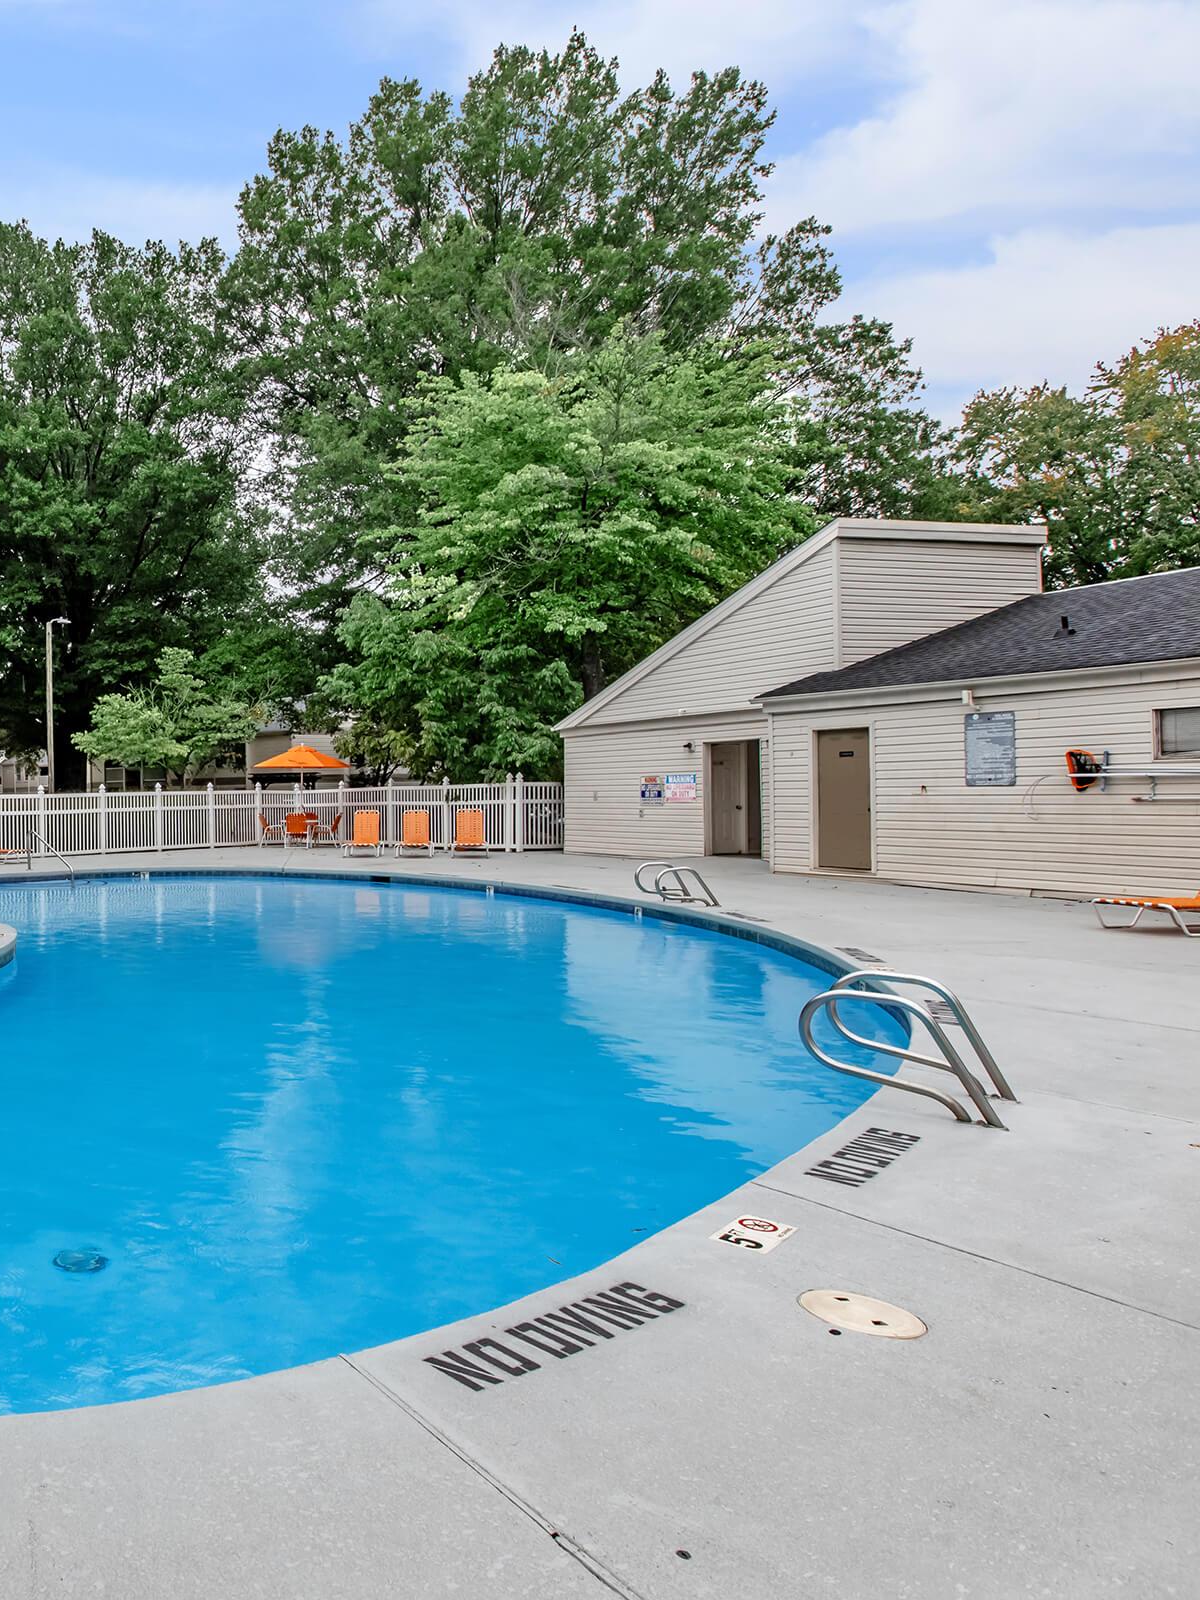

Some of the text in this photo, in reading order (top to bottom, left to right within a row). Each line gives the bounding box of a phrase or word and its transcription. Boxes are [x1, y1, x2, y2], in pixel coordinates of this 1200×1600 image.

[803, 1127, 921, 1188] NO DIVING
[718, 1233, 764, 1249] 5
[422, 1281, 686, 1392] NO DIVING
